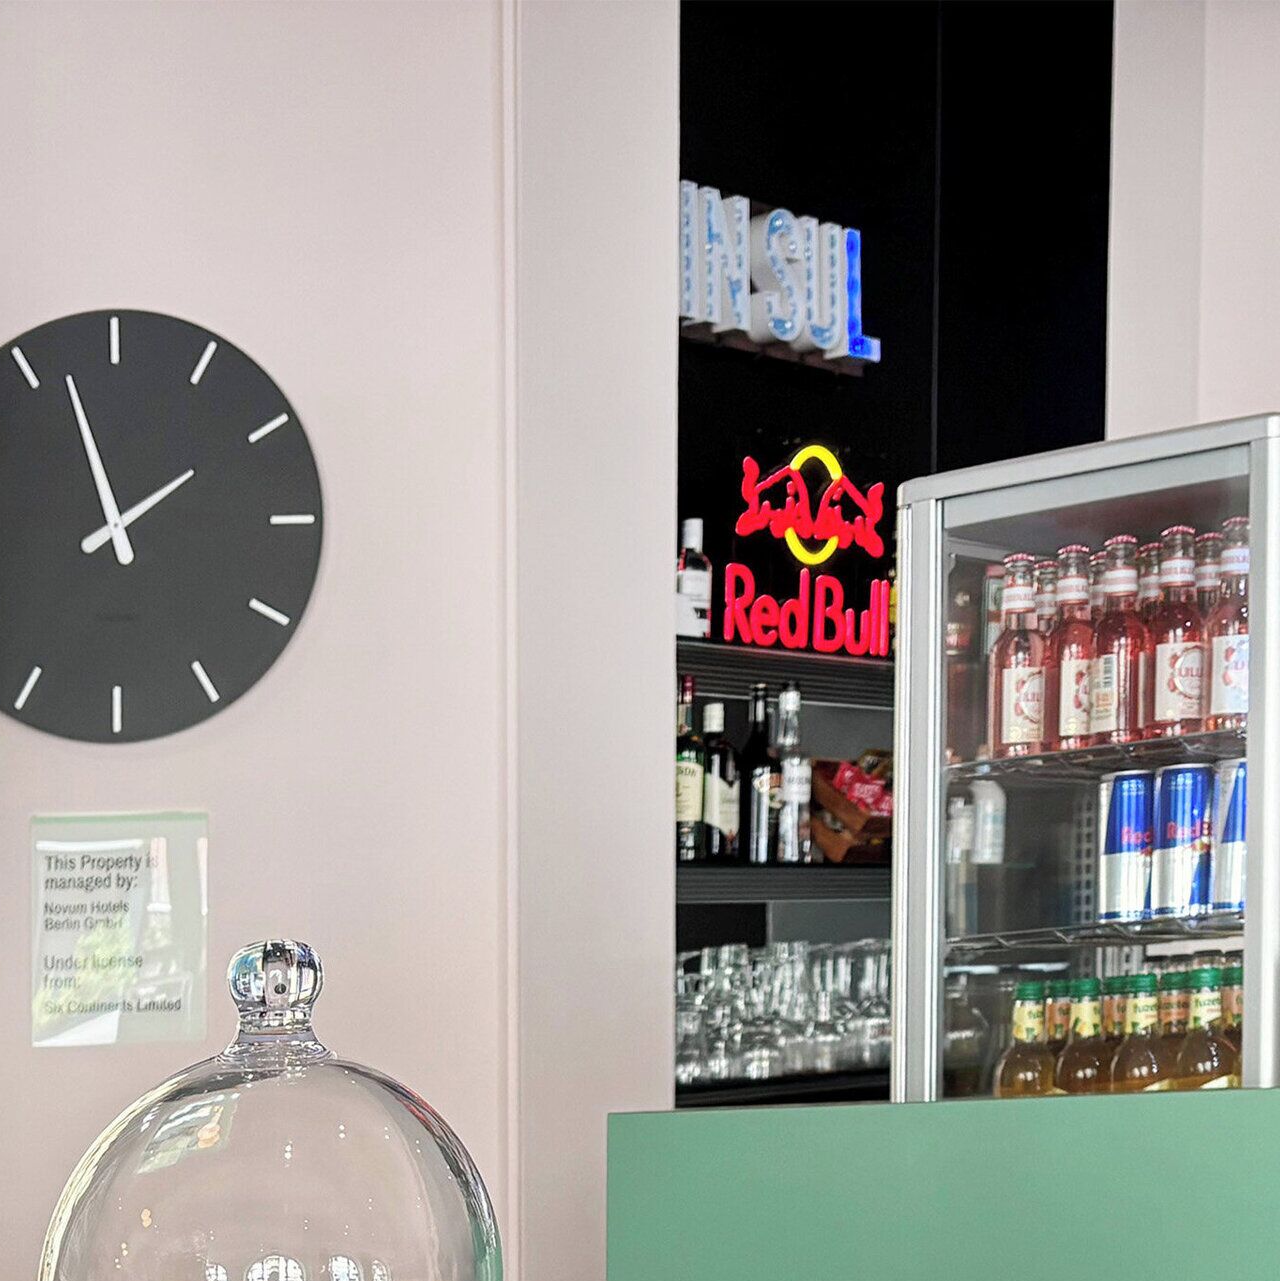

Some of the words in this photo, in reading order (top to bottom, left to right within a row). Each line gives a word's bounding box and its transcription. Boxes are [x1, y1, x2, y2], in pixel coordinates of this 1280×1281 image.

[724, 563, 811, 648] Red
[812, 574, 890, 657] Bull
[44, 855, 76, 871] This
[81, 853, 142, 872] Property
[44, 875, 111, 892] managed
[116, 874, 138, 890] by:
[44, 902, 86, 914] Novum
[90, 900, 129, 913] Hotels
[44, 918, 80, 931] Berlin
[43, 955, 87, 971] Under
[92, 953, 143, 968] license
[43, 975, 81, 989] from:
[44, 1001, 63, 1014] Six
[67, 999, 133, 1014] Continents
[137, 998, 181, 1012] Limited
